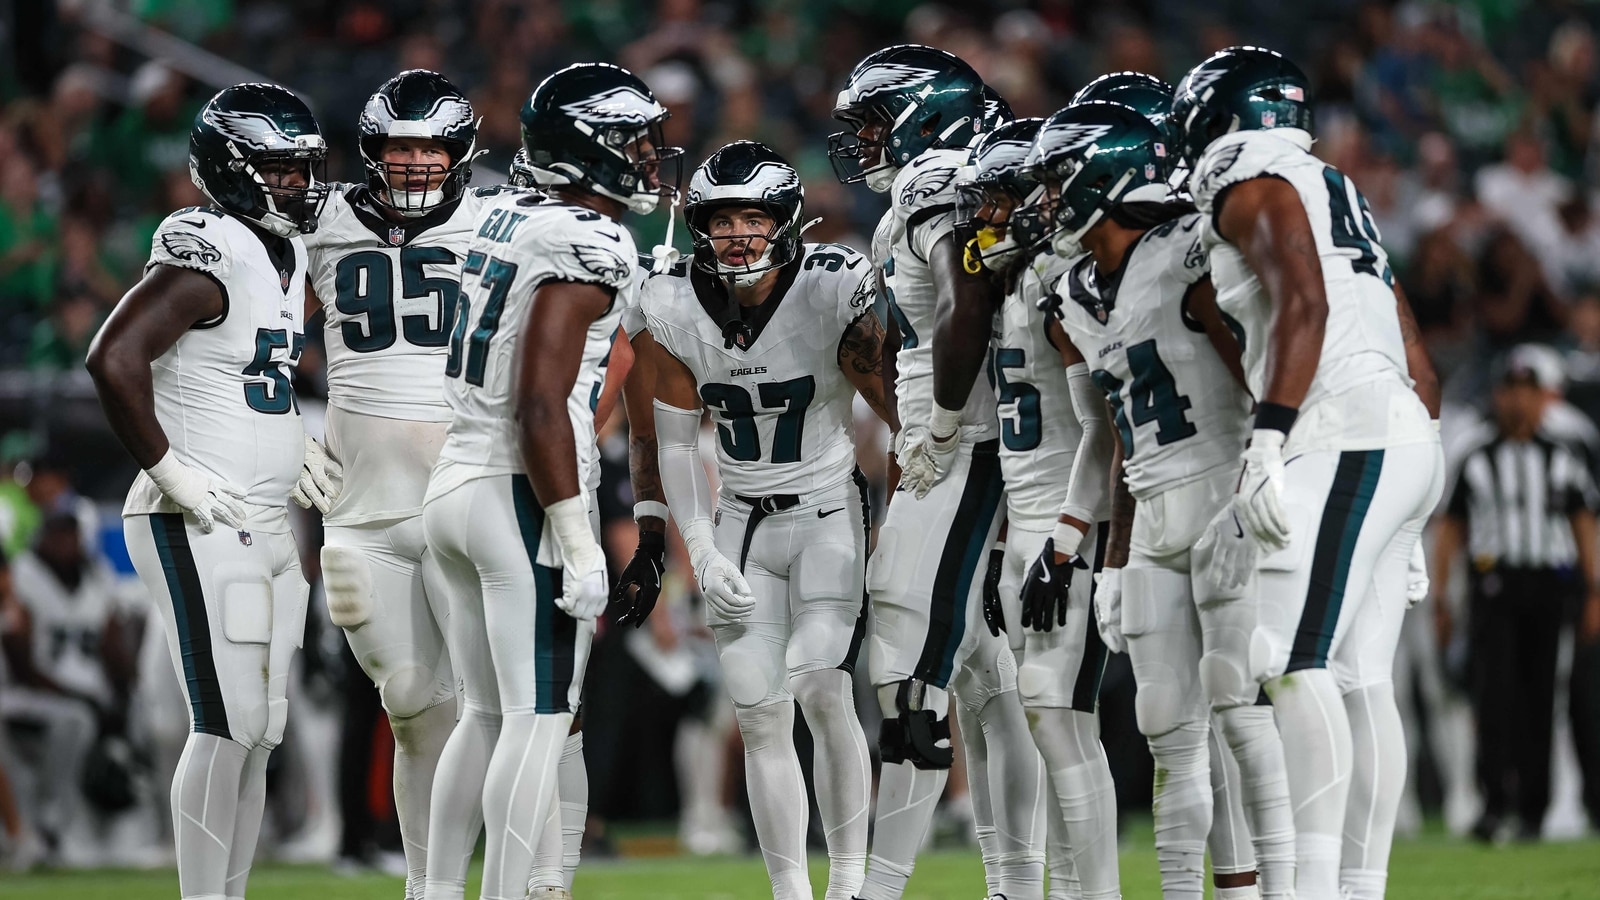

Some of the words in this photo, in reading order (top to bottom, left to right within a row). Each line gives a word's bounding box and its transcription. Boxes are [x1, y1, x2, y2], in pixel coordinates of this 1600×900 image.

[335, 247, 460, 353] 95
[730, 366, 767, 377] EAGLES
[700, 374, 816, 464] 37
